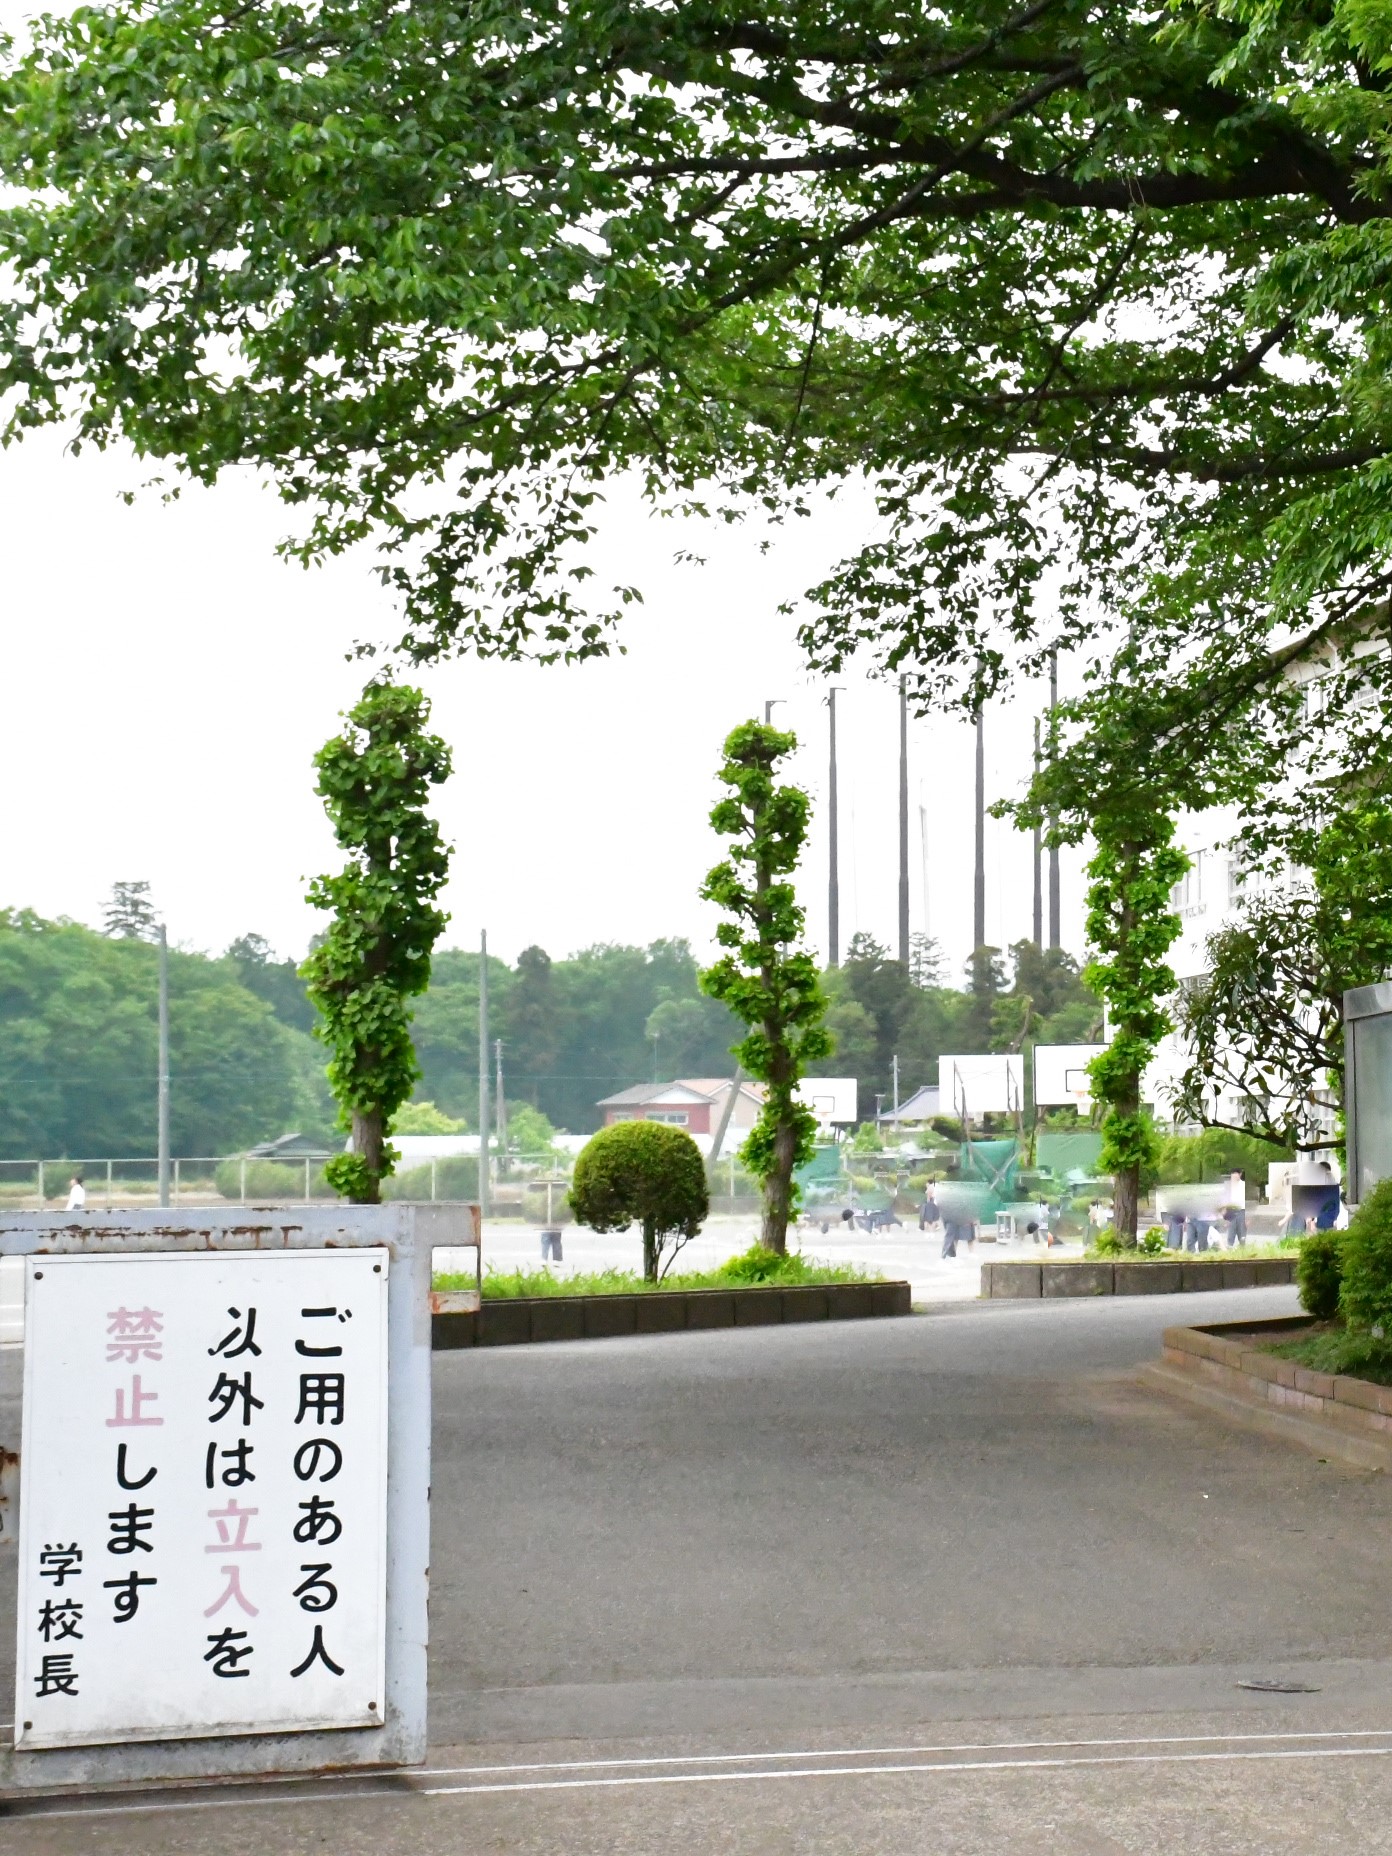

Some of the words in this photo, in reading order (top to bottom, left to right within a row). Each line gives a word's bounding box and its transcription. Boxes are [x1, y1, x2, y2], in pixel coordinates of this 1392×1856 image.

[33, 1542, 83, 1697] 学校長
[101, 1305, 162, 1623] 禁止します
[203, 1306, 264, 1677] 以外は立入を
[289, 1306, 352, 1677] ご用のある人
